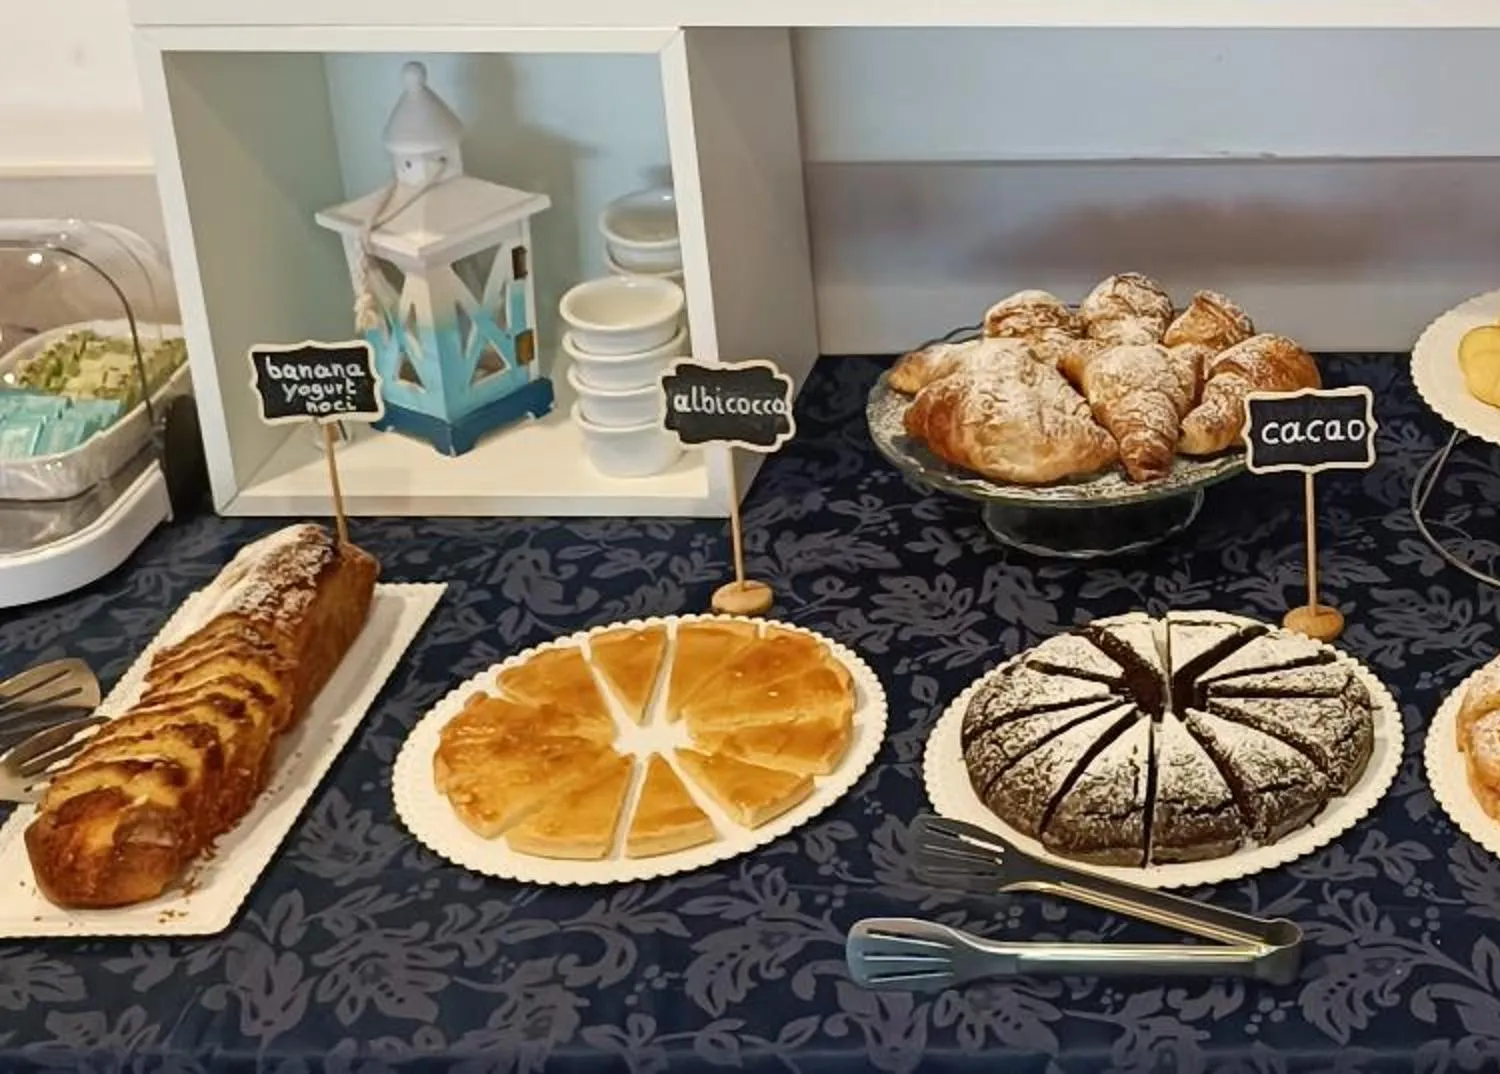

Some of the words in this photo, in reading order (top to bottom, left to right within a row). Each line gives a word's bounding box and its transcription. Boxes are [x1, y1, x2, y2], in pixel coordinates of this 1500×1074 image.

[265, 355, 365, 380] banana
[281, 378, 357, 402] yogurt
[305, 395, 357, 413] noci
[1261, 419, 1366, 445] cacao
